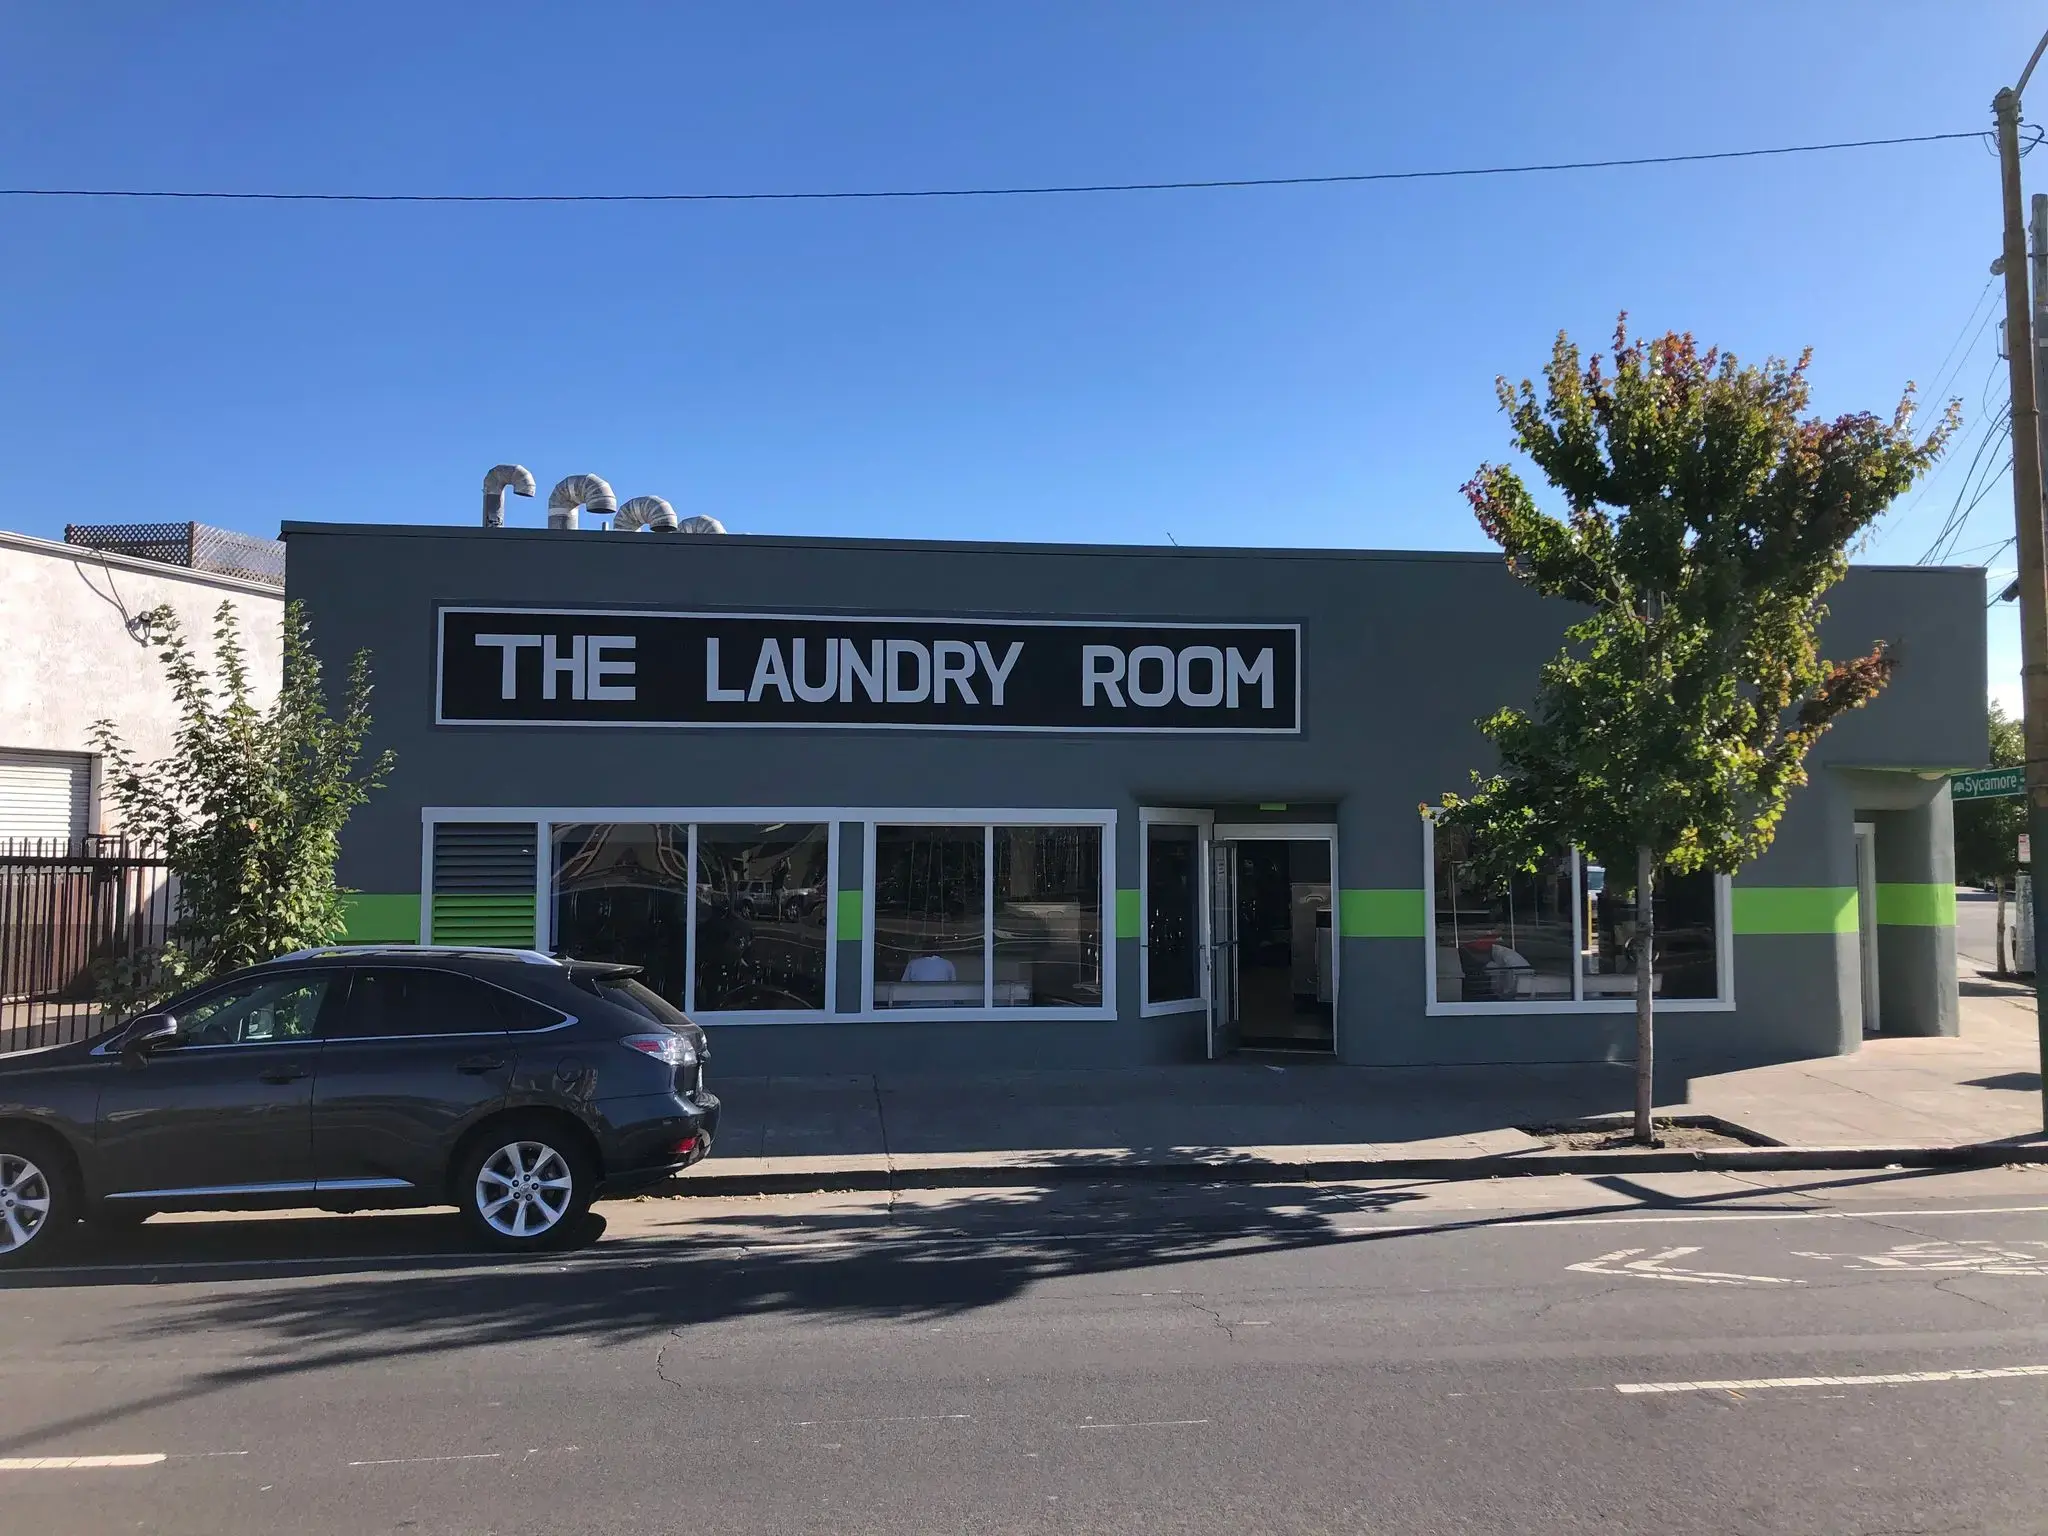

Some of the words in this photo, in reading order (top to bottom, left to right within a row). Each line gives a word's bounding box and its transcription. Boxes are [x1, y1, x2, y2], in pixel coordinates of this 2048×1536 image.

[475, 633, 637, 701] THE
[705, 637, 1025, 706] LAUNDRY
[1082, 644, 1275, 710] ROOM
[1964, 775, 2018, 796] Sycamore
